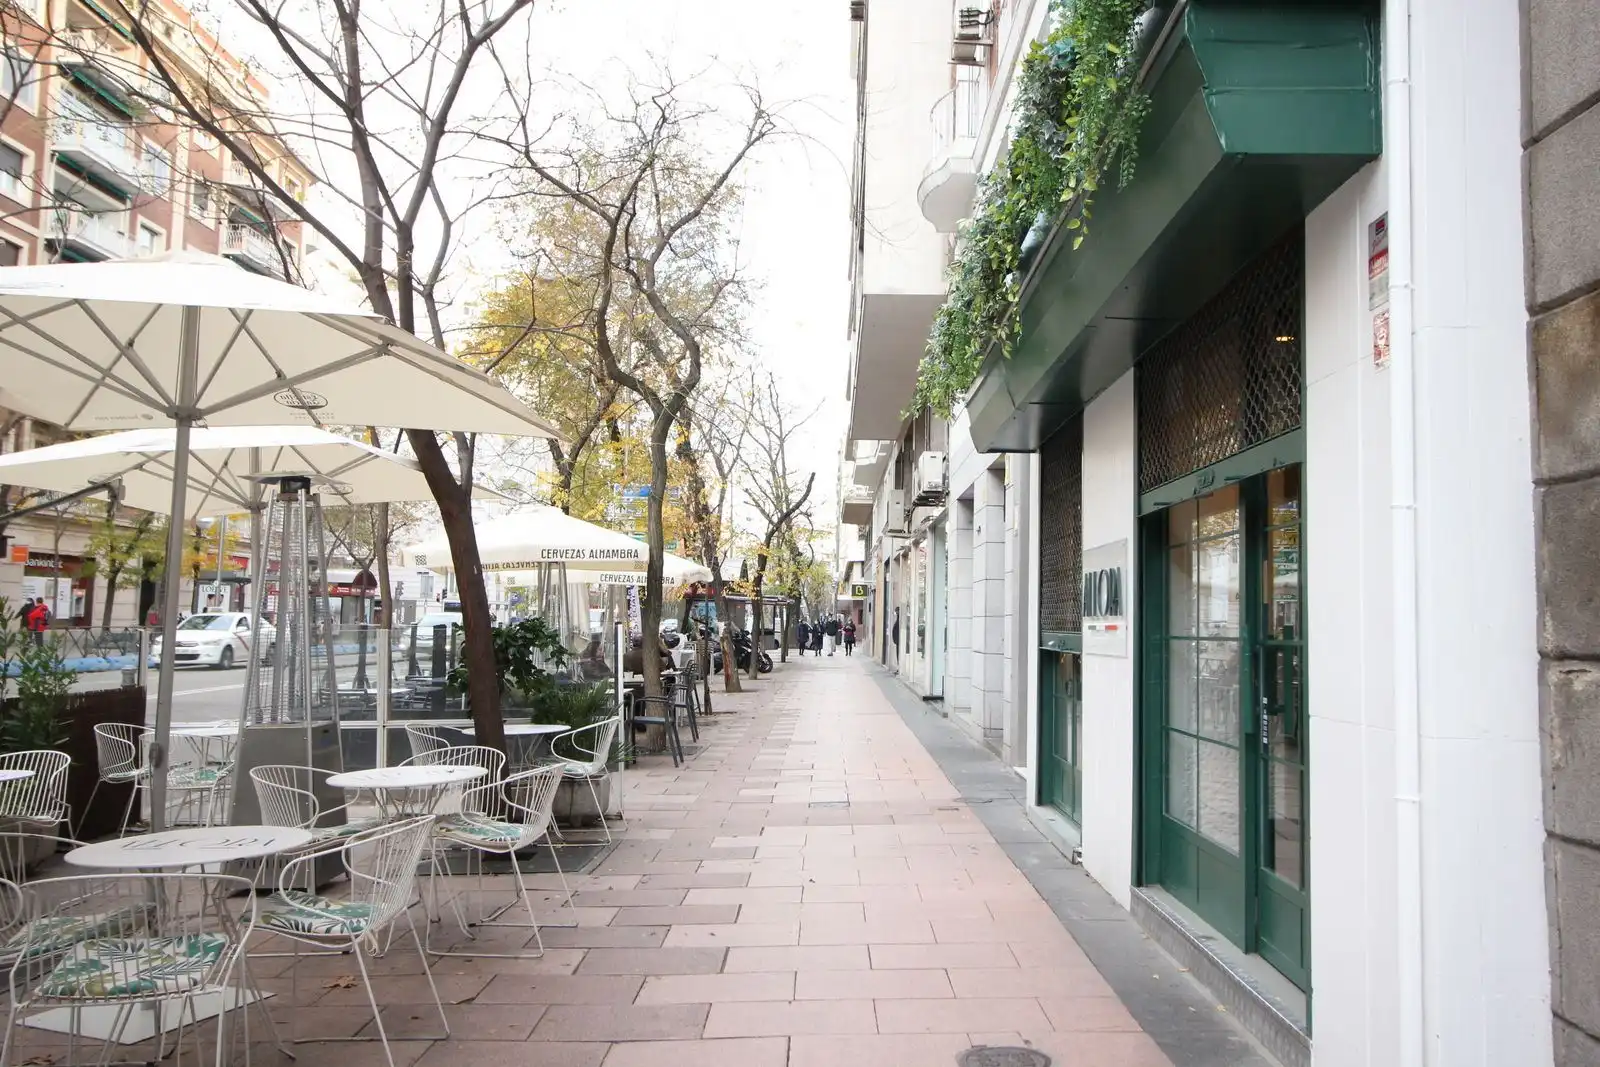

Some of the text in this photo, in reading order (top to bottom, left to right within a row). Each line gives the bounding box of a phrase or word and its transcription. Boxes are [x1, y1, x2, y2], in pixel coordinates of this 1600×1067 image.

[540, 548, 639, 560] CERVEZAS ALHAMBRA
[600, 573, 635, 584] CERVEZAS
